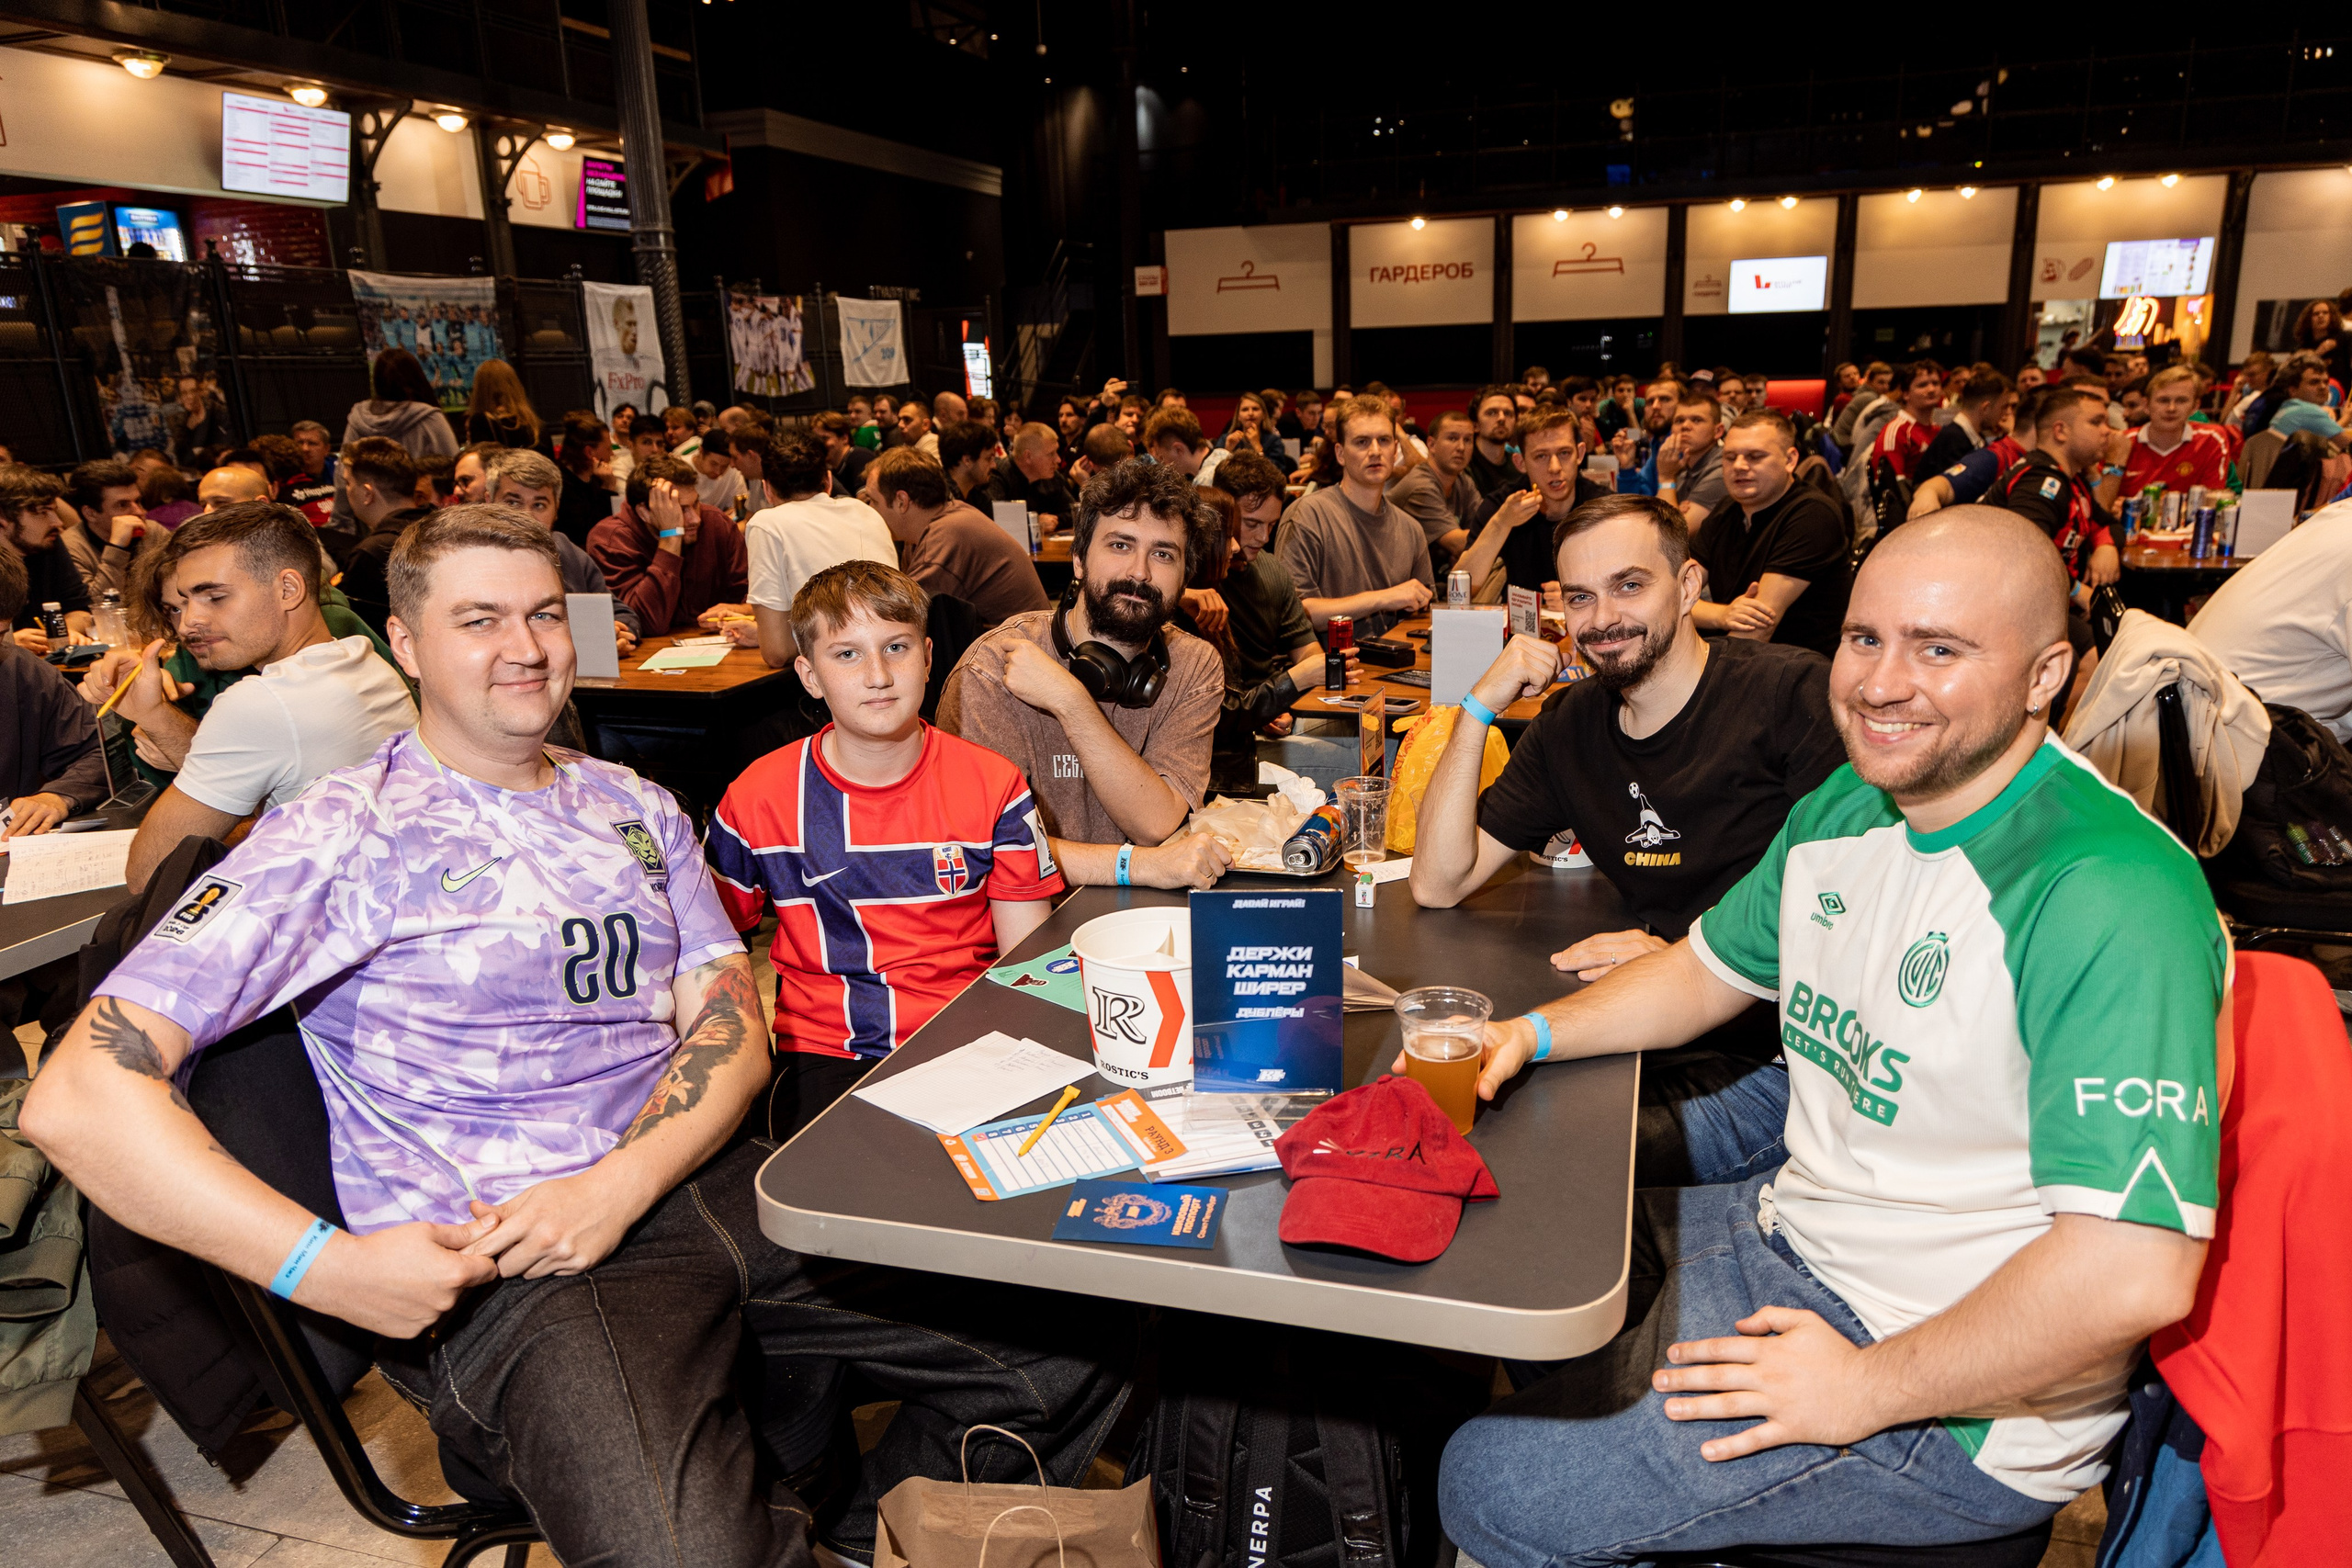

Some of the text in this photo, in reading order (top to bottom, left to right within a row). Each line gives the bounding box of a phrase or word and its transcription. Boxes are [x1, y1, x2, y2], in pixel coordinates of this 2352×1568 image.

[1370, 262, 1474, 284] ГАРДЕРОБ
[608, 372, 646, 390] FxPro
[56, 614, 67, 637] Rich
[1624, 852, 1681, 866] CHINA
[1232, 898, 1306, 908] ДАВАЙ ИГРАЙ!
[179, 911, 195, 921] FIFA
[1810, 911, 1834, 931] umbro
[561, 911, 640, 1005] 20
[1227, 946, 1313, 962] ДЕРЖИ
[1226, 964, 1314, 978] КАРМАН
[1233, 981, 1306, 996] ШИРЕР
[1092, 986, 1147, 1044] R
[1236, 1006, 1305, 1018] ДУБЛЁРЫ
[1786, 980, 1911, 1093] BROOKS
[1786, 1029, 1826, 1064] LET'S
[1100, 1059, 1148, 1080] ROSTIC'S
[1151, 1085, 1184, 1098] BETBOOM
[2074, 1077, 2209, 1126] FORA
[1145, 1125, 1170, 1154] РАУНД
[1182, 1198, 1202, 1234] паспорт
[1247, 1486, 1272, 1568] NERPA
